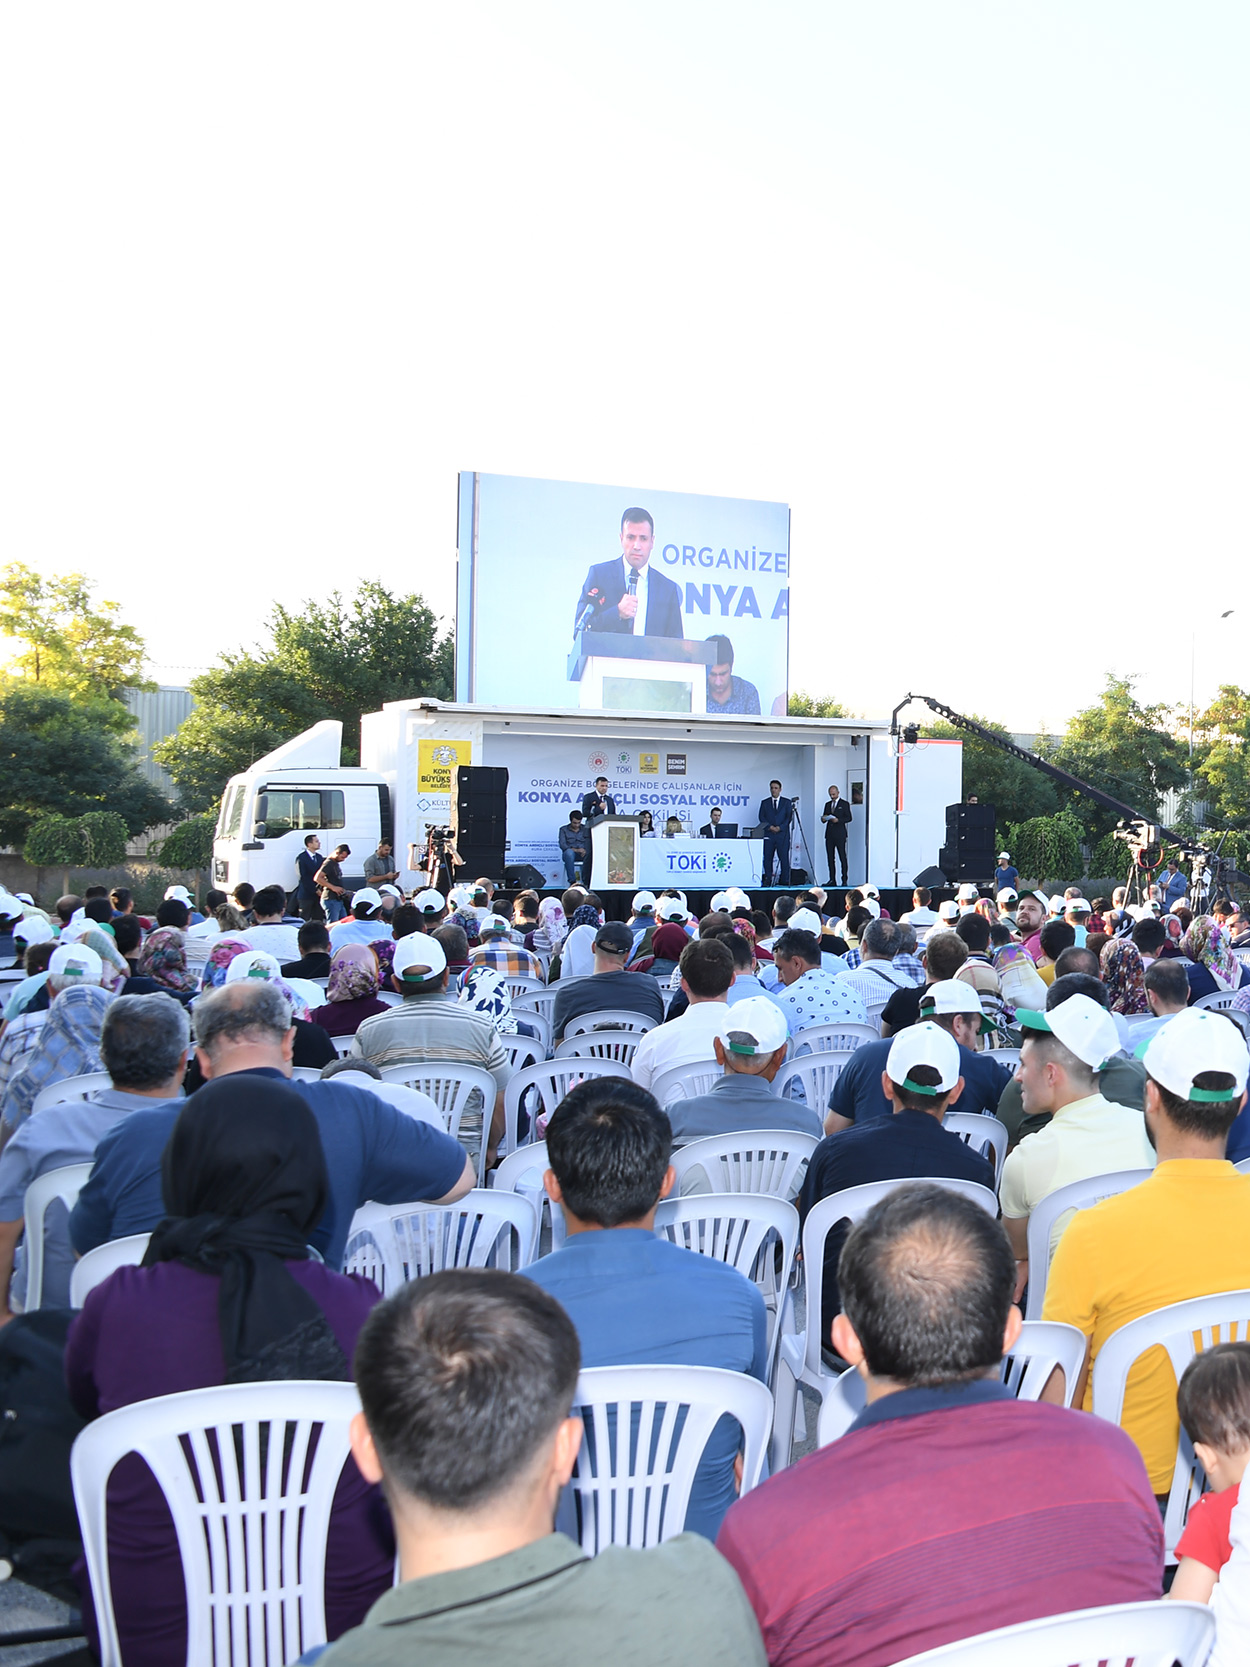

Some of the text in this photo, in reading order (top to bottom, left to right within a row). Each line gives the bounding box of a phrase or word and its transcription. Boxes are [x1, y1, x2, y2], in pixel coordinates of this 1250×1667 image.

[662, 544, 787, 573] ORGANİZE
[676, 581, 762, 619] NYA
[531, 778, 583, 788] ORGANİZE
[662, 782, 721, 792] ÇALIŞANLAR
[724, 782, 742, 792] İÇİN
[518, 791, 572, 804] KONYA
[640, 794, 697, 806] SOSYAL
[701, 795, 750, 807] KONUT
